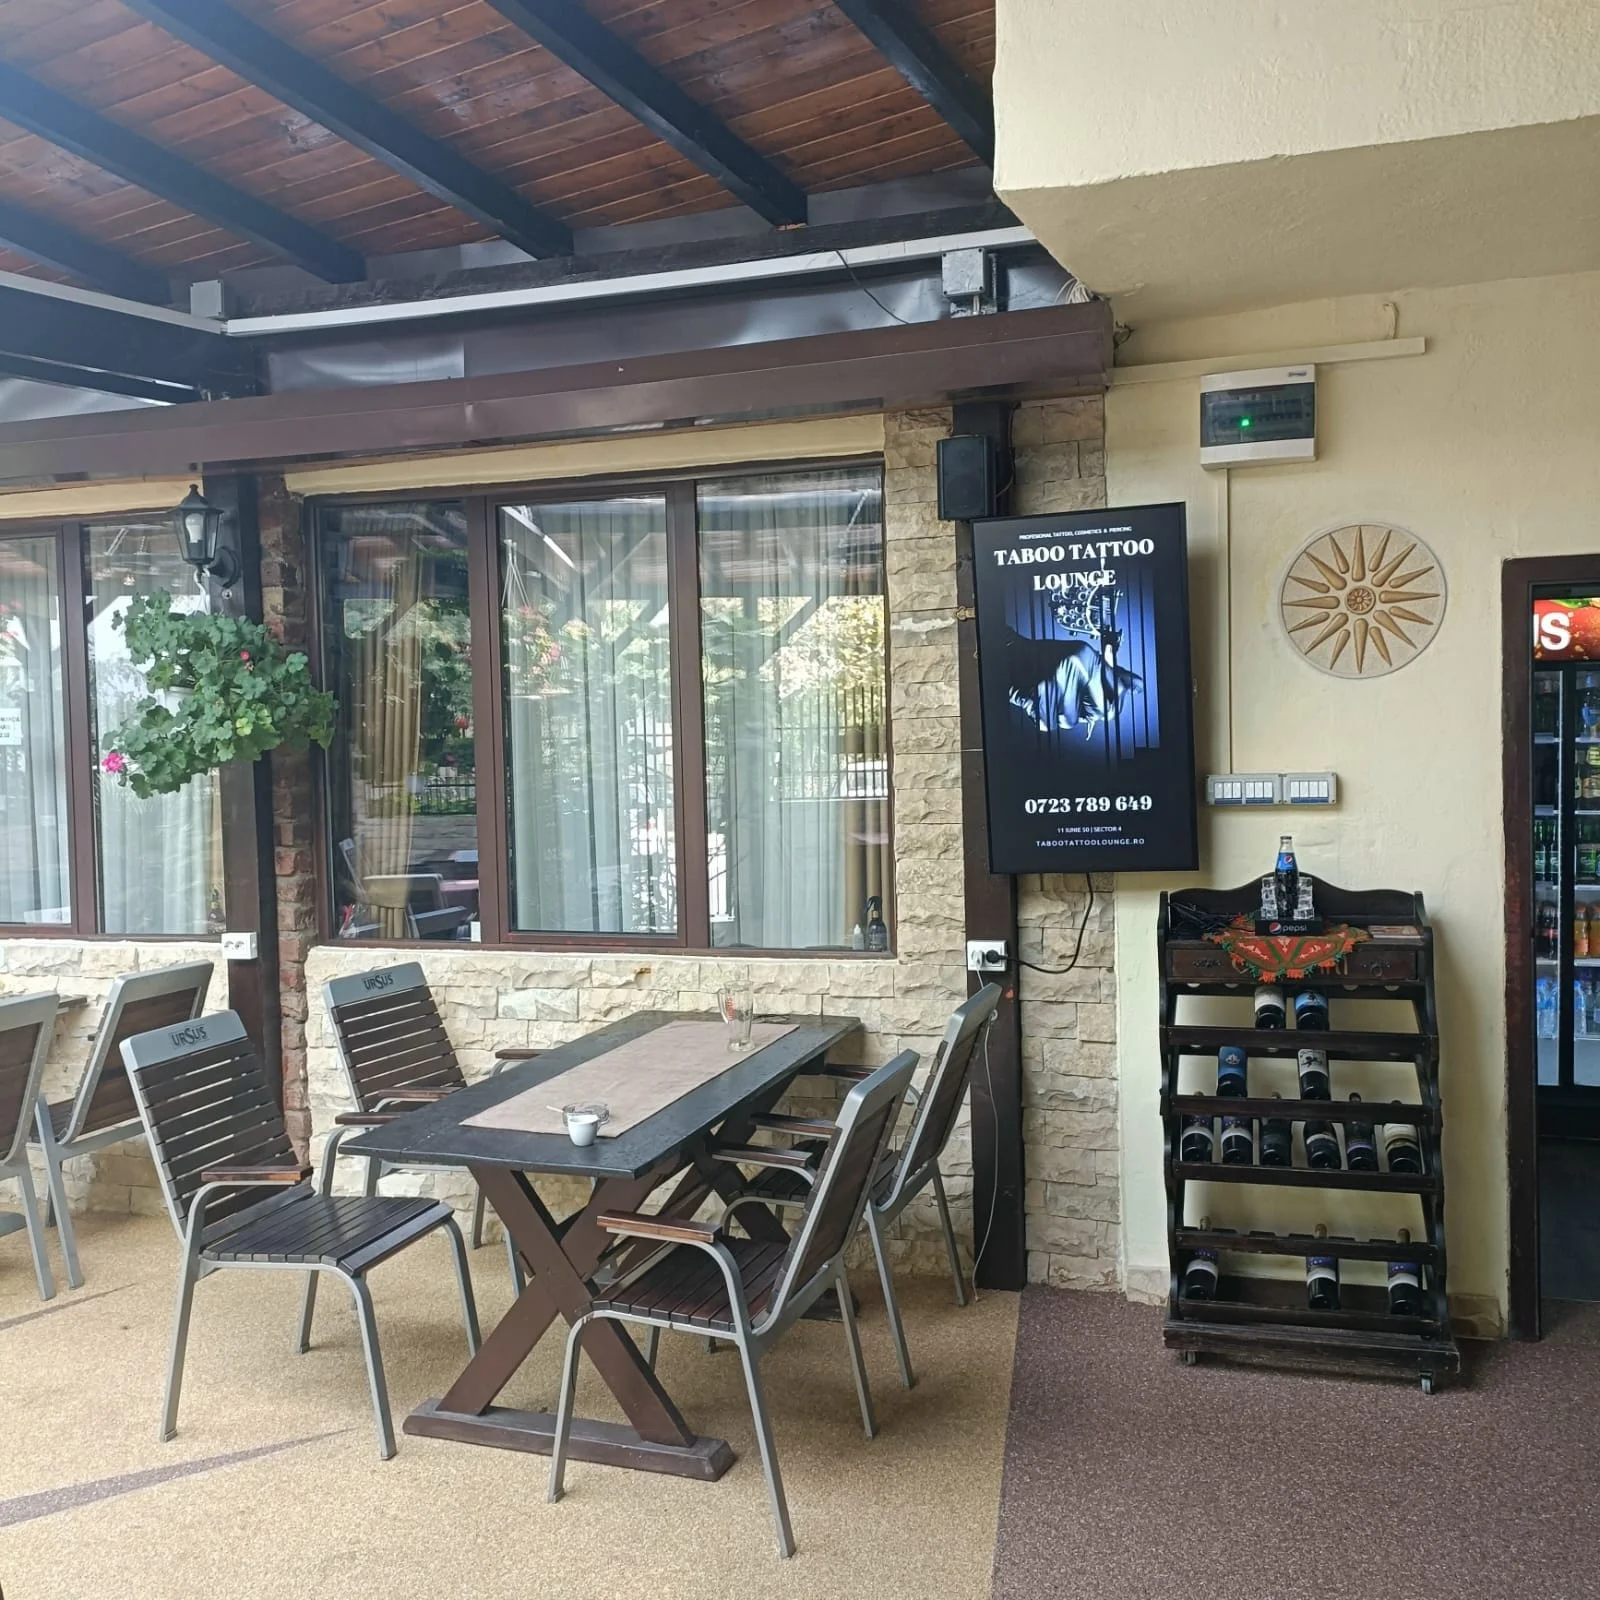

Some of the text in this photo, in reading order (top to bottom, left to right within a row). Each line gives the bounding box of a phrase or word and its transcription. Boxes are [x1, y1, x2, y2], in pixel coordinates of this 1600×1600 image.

[994, 538, 1154, 566] TABOO TATTOO
[1033, 569, 1116, 591] LOUNGE
[1024, 795, 1153, 814] 0723 789 649
[1036, 838, 1145, 847] TABOOTATTOOLOUNGE.RO
[1282, 922, 1308, 933] pepsi
[363, 974, 394, 991] URSUS
[171, 1026, 208, 1046] URSUS
